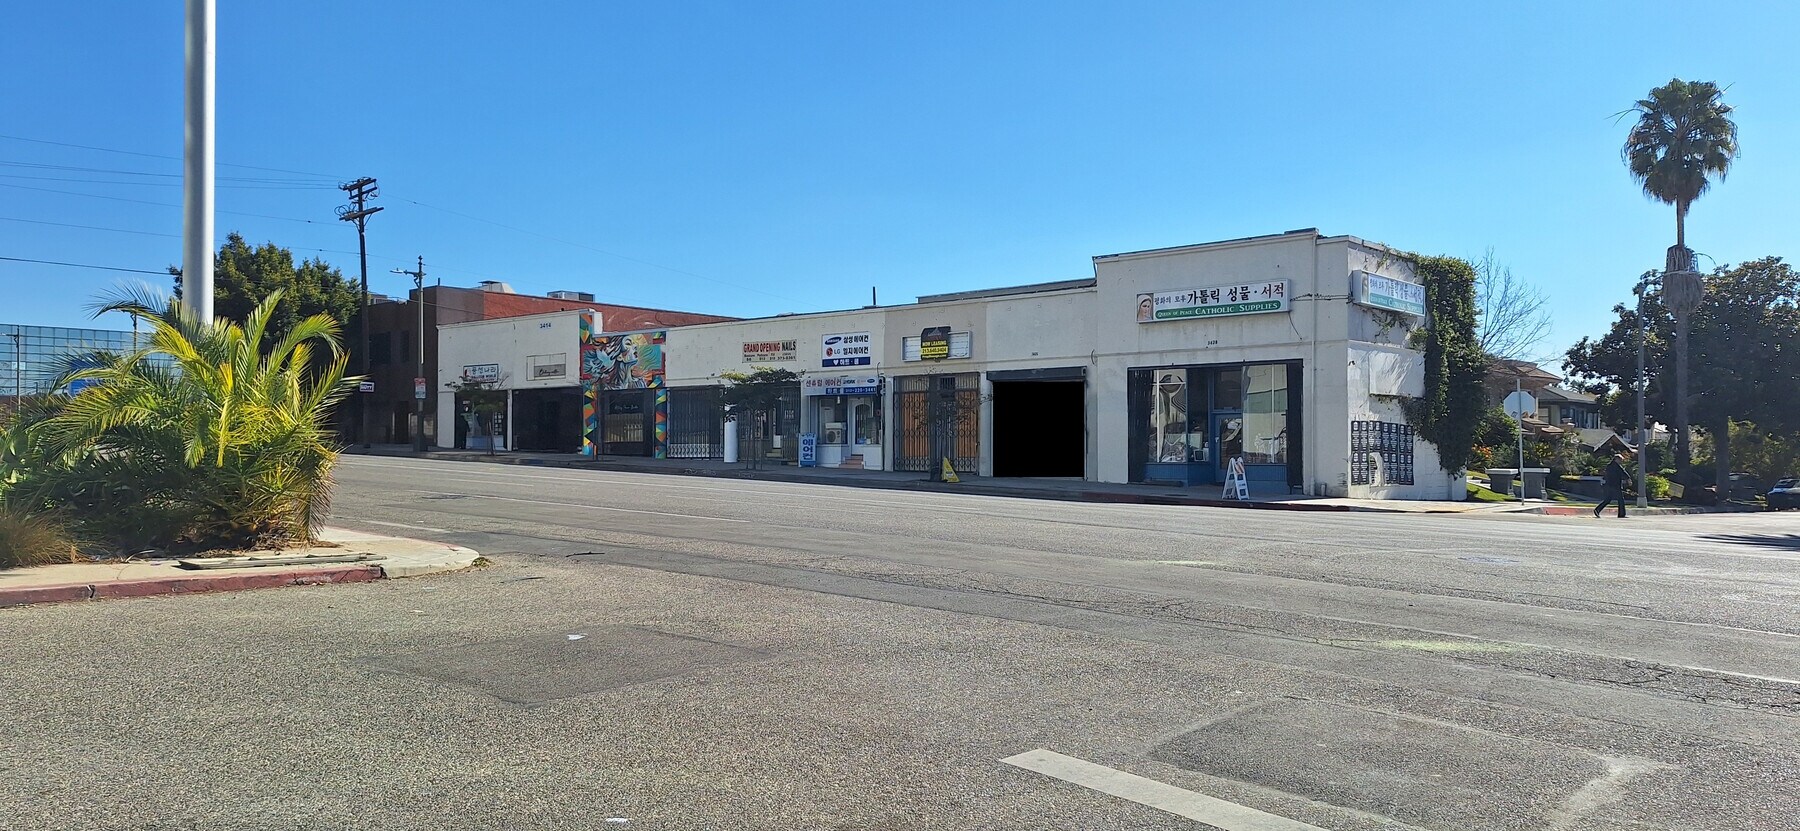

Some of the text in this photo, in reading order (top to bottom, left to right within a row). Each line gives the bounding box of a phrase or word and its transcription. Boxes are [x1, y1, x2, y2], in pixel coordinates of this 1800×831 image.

[1187, 289, 1220, 305] 가톨릭
[1195, 306, 1234, 315] CATHOLIC
[1239, 302, 1278, 312] SUPPLIES
[744, 341, 796, 352] GRAND OPENING NAILS
